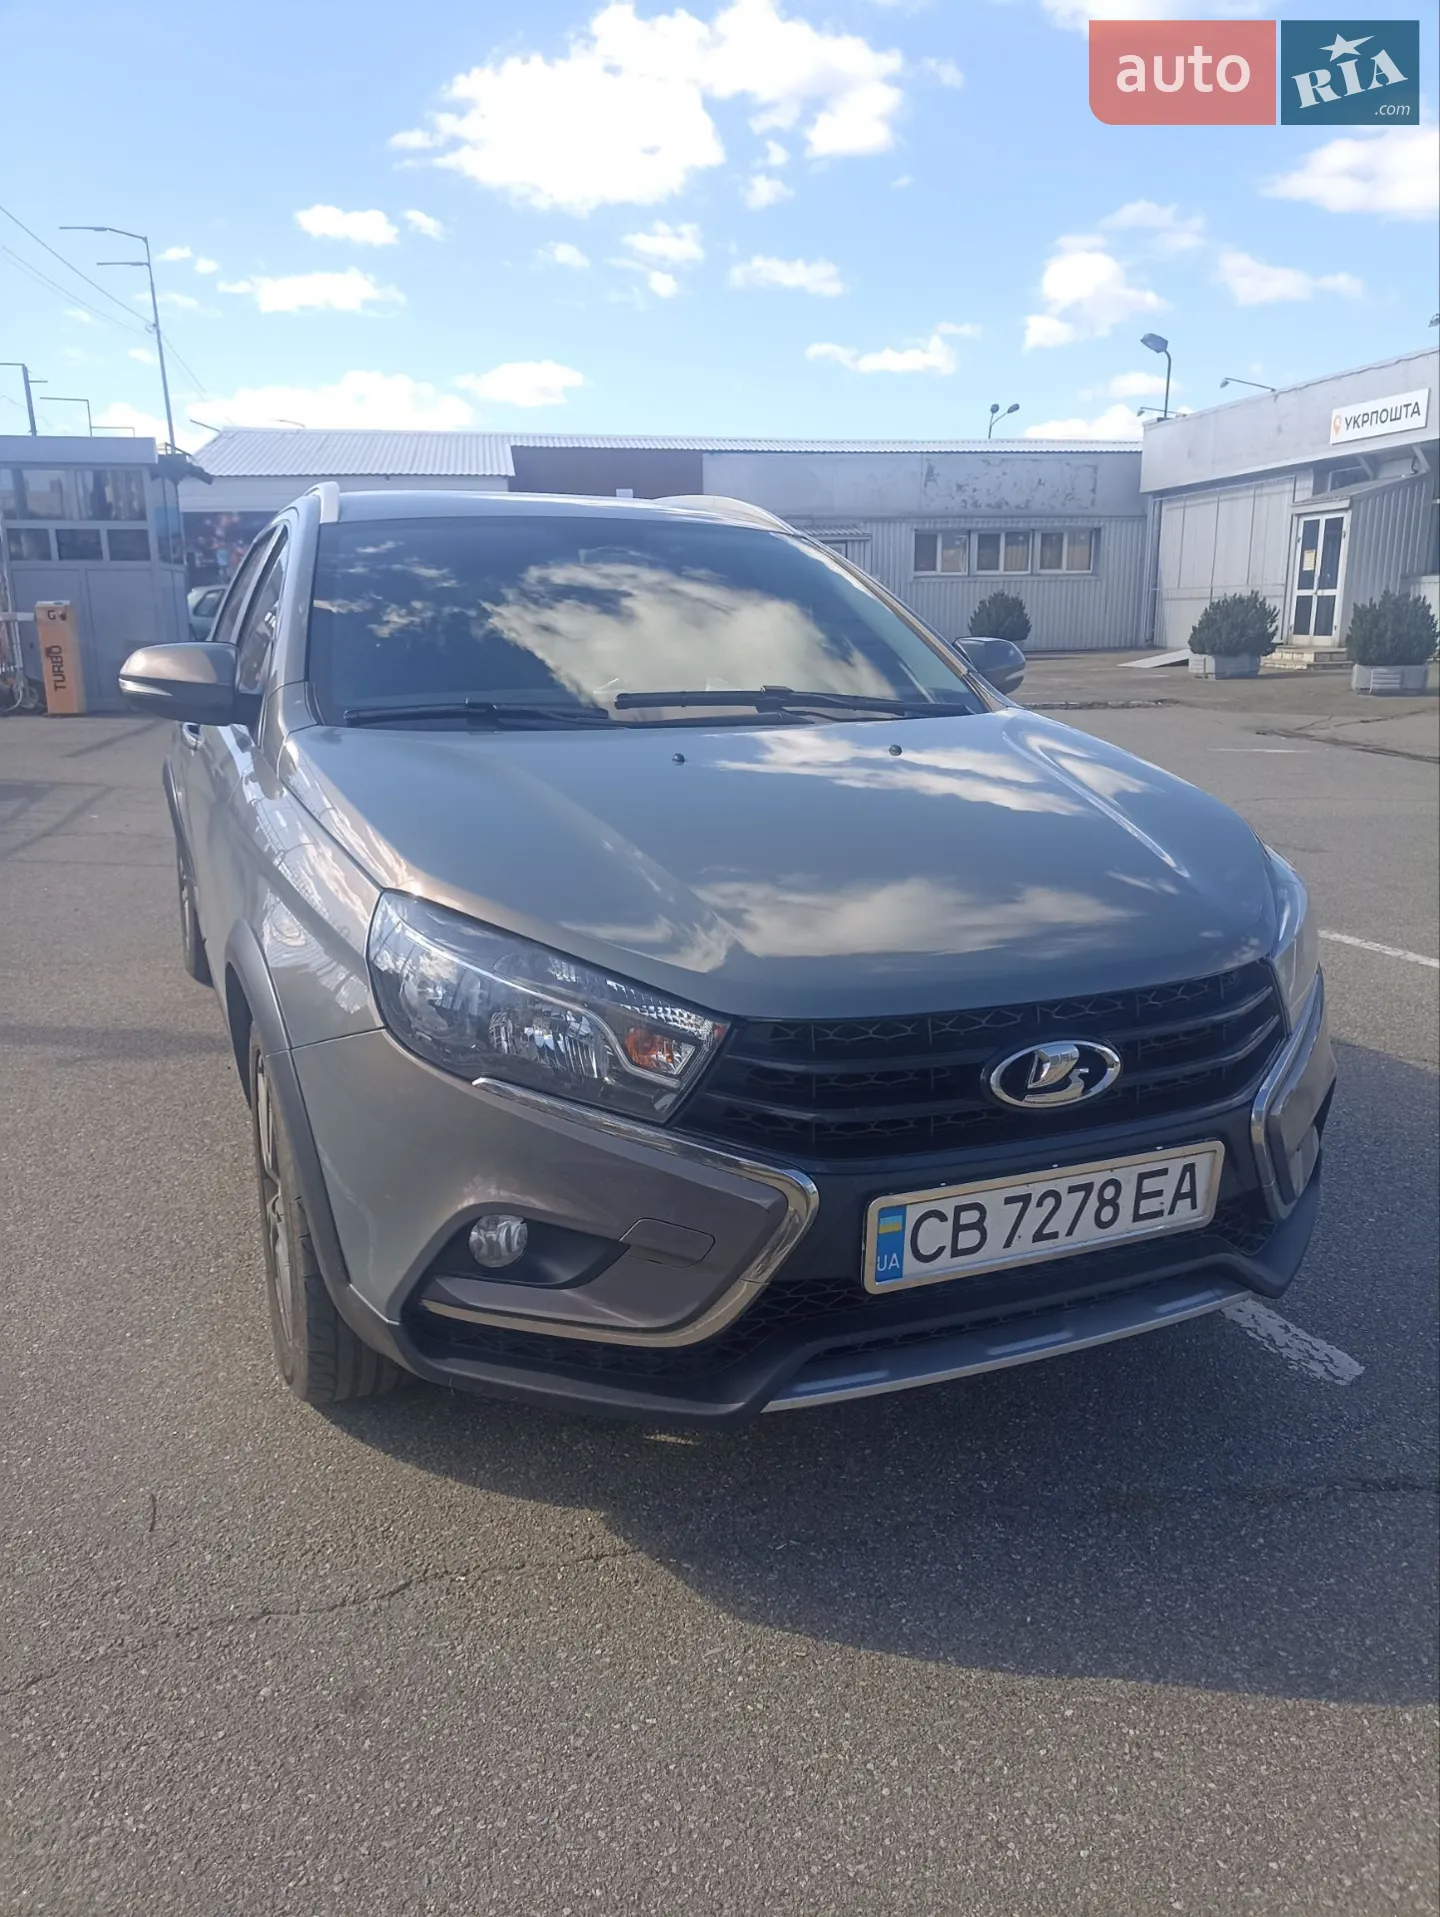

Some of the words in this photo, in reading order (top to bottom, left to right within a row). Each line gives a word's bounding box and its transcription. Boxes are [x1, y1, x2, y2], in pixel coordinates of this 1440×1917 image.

[1344, 401, 1421, 430] УКРПОШТА
[51, 645, 67, 691] TURBO
[910, 1202, 987, 1263] CB
[1003, 1178, 1122, 1249] 7278
[1132, 1162, 1198, 1223] EA
[877, 1252, 900, 1271] UA
